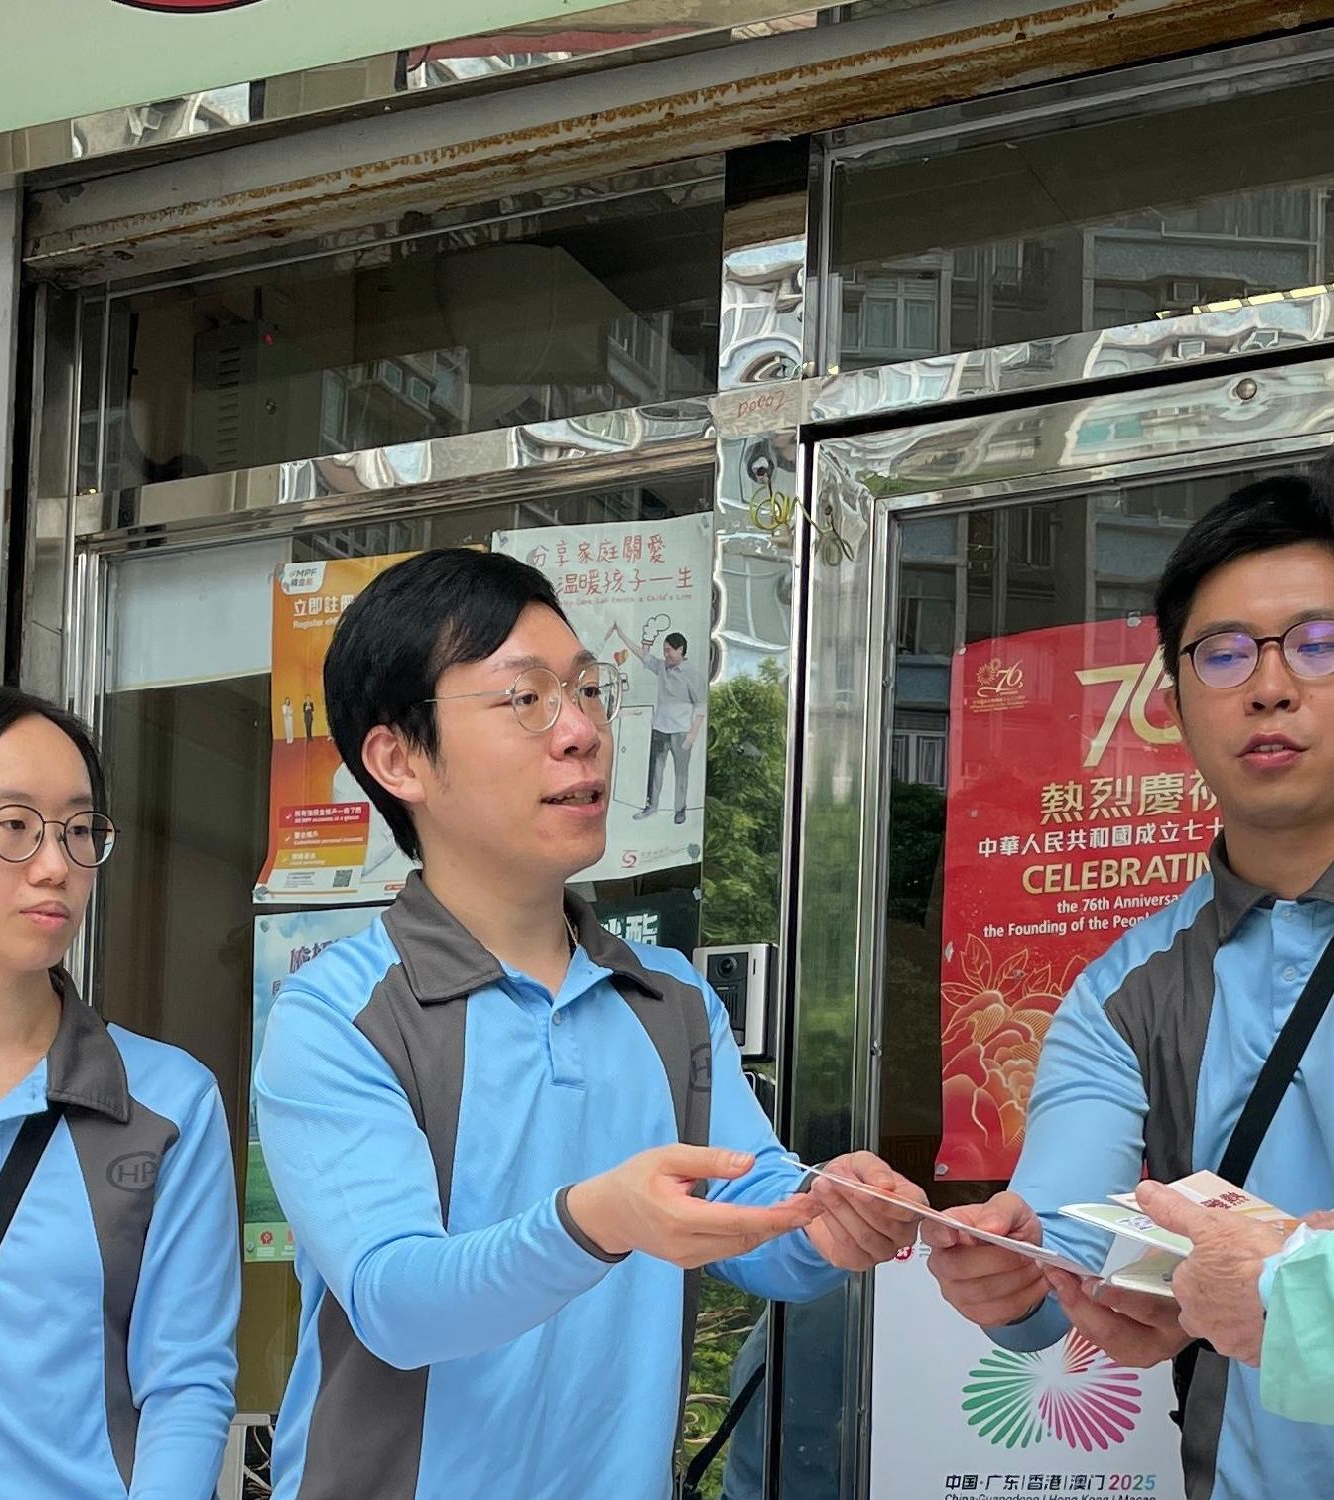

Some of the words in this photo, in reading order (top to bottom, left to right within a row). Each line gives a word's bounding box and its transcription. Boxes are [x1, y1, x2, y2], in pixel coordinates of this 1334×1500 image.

[529, 533, 666, 568] 分享家庭關愛
[978, 817, 1225, 858] 中華人民共和國成立七十
[1022, 852, 1212, 895] CELEBRATIN
[1057, 899, 1079, 915] the
[1082, 896, 1110, 912] 76th
[1114, 893, 1183, 910] Anniversa
[983, 924, 1004, 939] the
[1008, 919, 1068, 938] Founding
[1071, 917, 1086, 932] of
[1088, 915, 1110, 931] the
[1113, 912, 1150, 929] Peop
[1108, 1474, 1157, 1490] 2025
